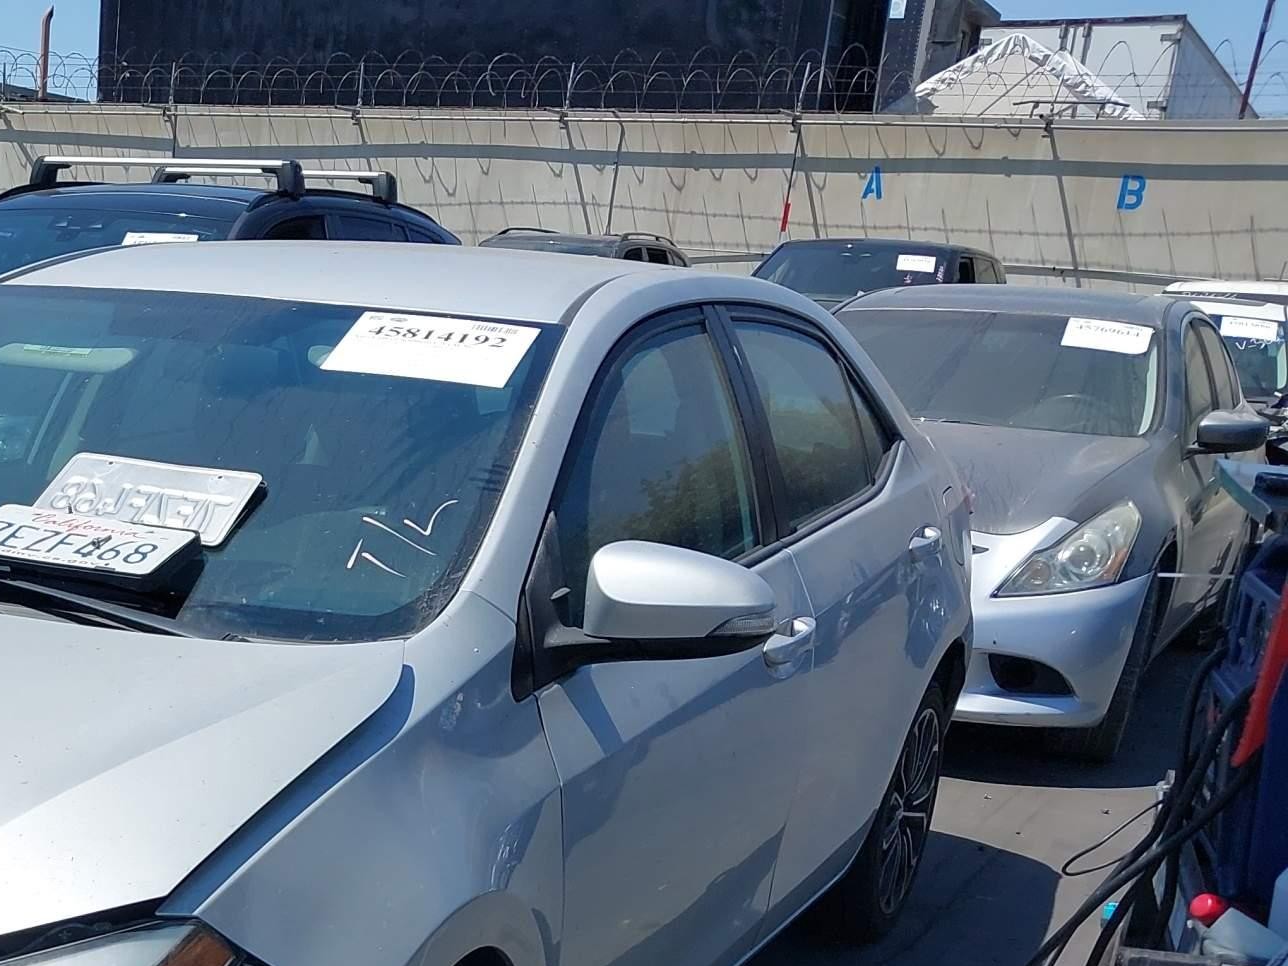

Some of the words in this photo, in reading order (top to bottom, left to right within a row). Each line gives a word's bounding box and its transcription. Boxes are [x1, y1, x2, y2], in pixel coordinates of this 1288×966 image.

[862, 166, 883, 199] A
[1116, 174, 1147, 211] B
[368, 324, 508, 348] 45814192
[31, 512, 147, 540] California
